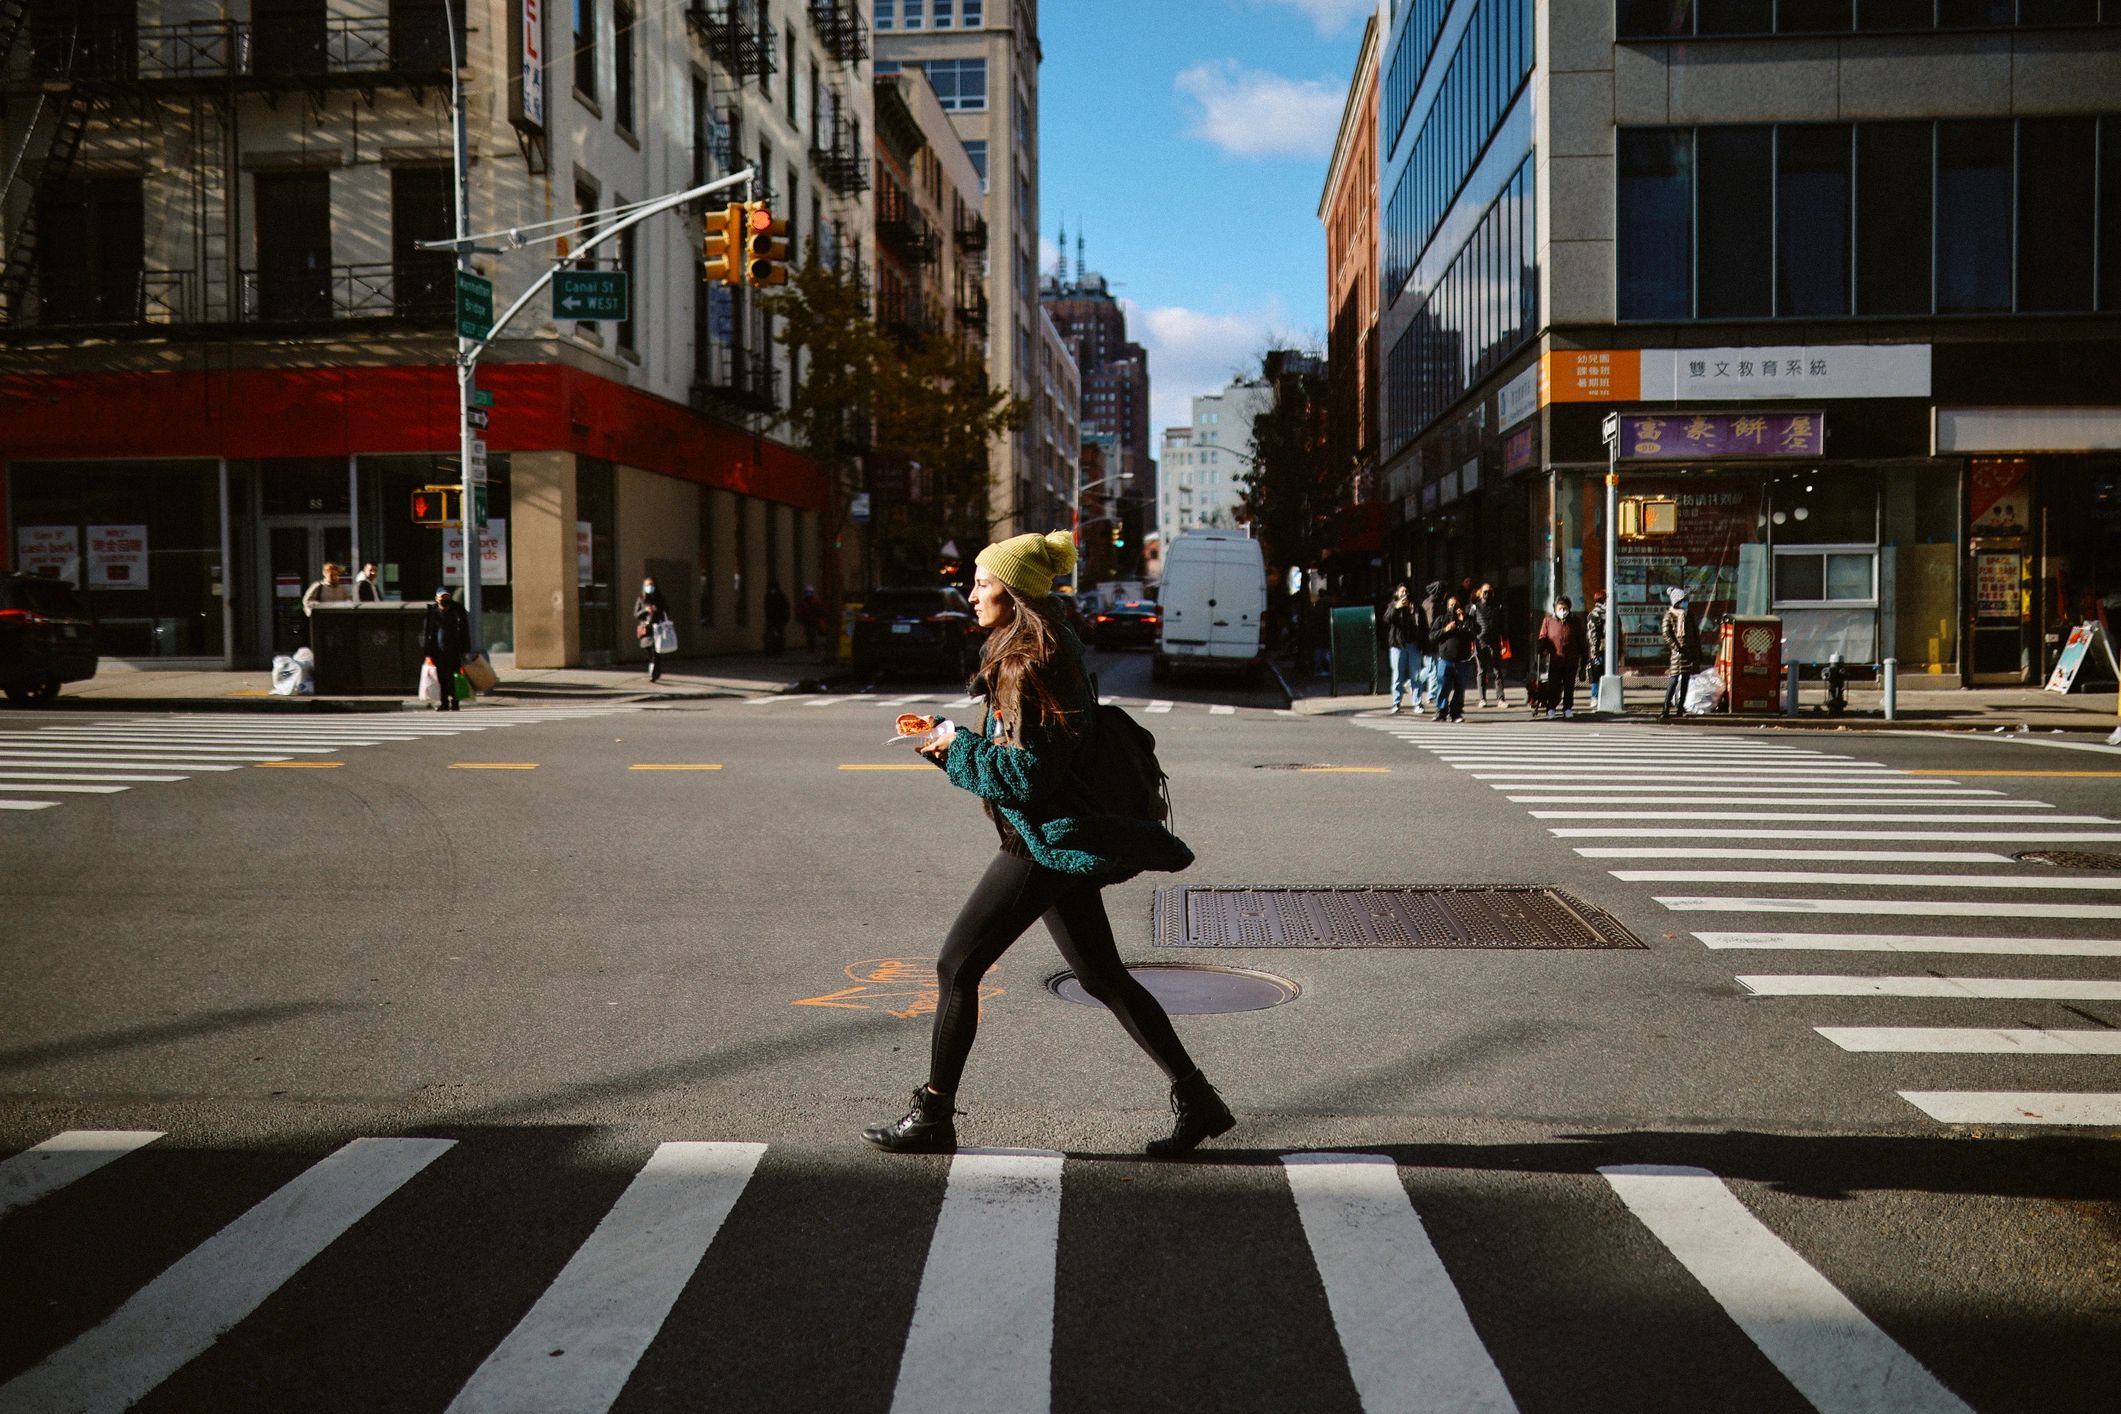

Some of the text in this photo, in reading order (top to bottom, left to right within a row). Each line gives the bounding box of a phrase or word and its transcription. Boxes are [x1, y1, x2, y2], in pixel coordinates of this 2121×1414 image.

[564, 280, 615, 293] Canal St
[587, 298, 619, 310] WEST
[1689, 359, 1827, 378] 雙文教育系統
[1633, 416, 1814, 449] 富豪餅屋
[451, 551, 497, 561] rerds
